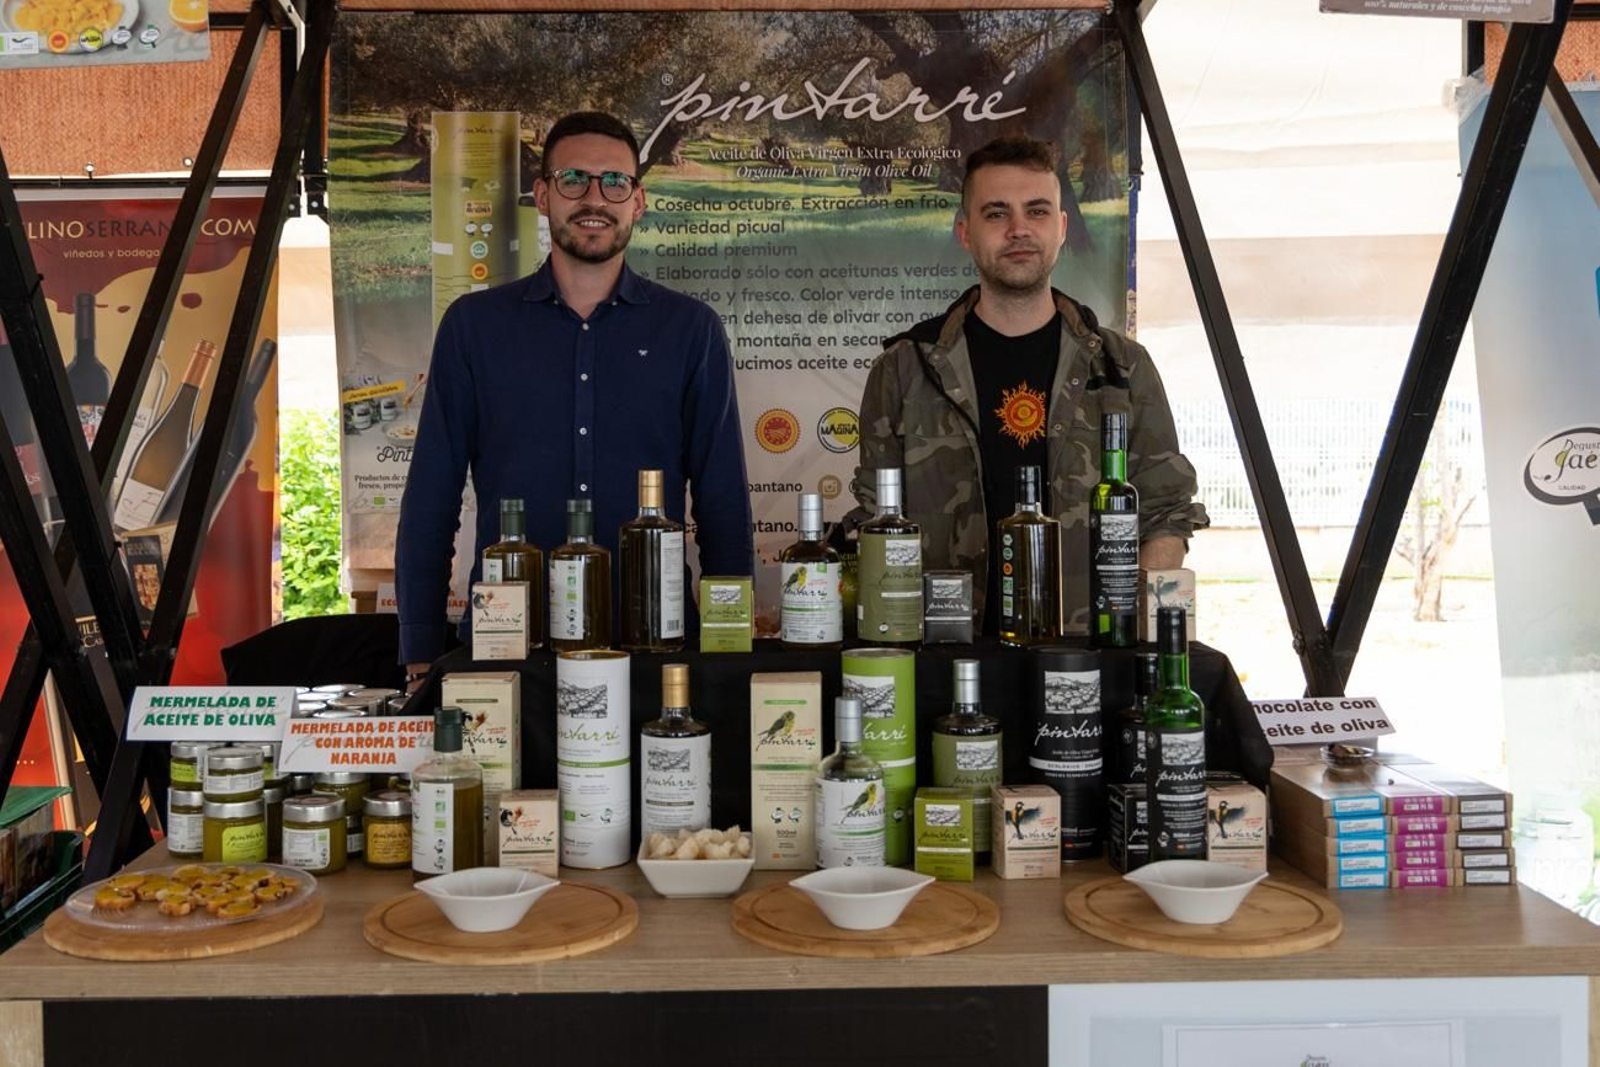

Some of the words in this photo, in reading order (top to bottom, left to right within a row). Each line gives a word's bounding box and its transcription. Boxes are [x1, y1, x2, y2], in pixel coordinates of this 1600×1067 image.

[708, 147, 749, 160] Aceite
[750, 147, 767, 160] de
[769, 147, 804, 160] Oliva
[806, 147, 854, 161] Virgen
[857, 147, 895, 160] Extra
[897, 146, 961, 161] Ecológico
[736, 165, 788, 180] Organic
[791, 165, 829, 178] Extra
[831, 164, 871, 179] Virgin
[874, 164, 909, 178] Olive
[911, 164, 932, 178] Oil
[655, 198, 723, 212] Cosecha
[728, 198, 795, 212] octubre.
[801, 196, 888, 210] Extracción
[894, 199, 914, 210] en
[919, 195, 949, 209] frío
[656, 220, 730, 235] Variedad
[736, 218, 785, 236] picual
[63, 250, 105, 259] viñedos
[108, 251, 114, 259] y
[117, 248, 161, 259] bodega
[656, 242, 718, 257] Calidad
[724, 244, 798, 260] premium
[656, 265, 741, 280] Elaborado
[747, 265, 779, 279] sólo
[785, 268, 815, 279] con
[819, 264, 898, 279] aceitunas
[903, 263, 957, 278] verdes
[726, 292, 736, 304] y
[742, 287, 795, 302] fresco.
[801, 287, 844, 301] Color
[849, 286, 896, 300] verde
[744, 310, 802, 325] dehesa
[808, 310, 828, 324] de
[833, 309, 880, 323] olivar
[885, 311, 914, 323] con
[737, 332, 811, 348] montaña
[818, 336, 837, 347] en
[735, 355, 792, 370] ucimos
[798, 355, 847, 370] aceite
[377, 446, 413, 463] Pint
[150, 696, 252, 708] MERMELADA
[255, 696, 277, 708] DE
[1340, 698, 1377, 711] con
[144, 714, 205, 726] ACEITE
[207, 714, 223, 726] DE
[229, 714, 276, 726] OLIVA
[291, 721, 376, 734] MERMELADA
[379, 721, 395, 733] DE
[398, 720, 434, 733] ACEIT
[1263, 722, 1305, 738] eite
[1311, 721, 1336, 735] de
[1341, 717, 1389, 733] oliva
[315, 737, 344, 749] CON
[346, 736, 395, 748] AROMA
[398, 736, 415, 748] DE
[331, 752, 396, 765] NARANJA
